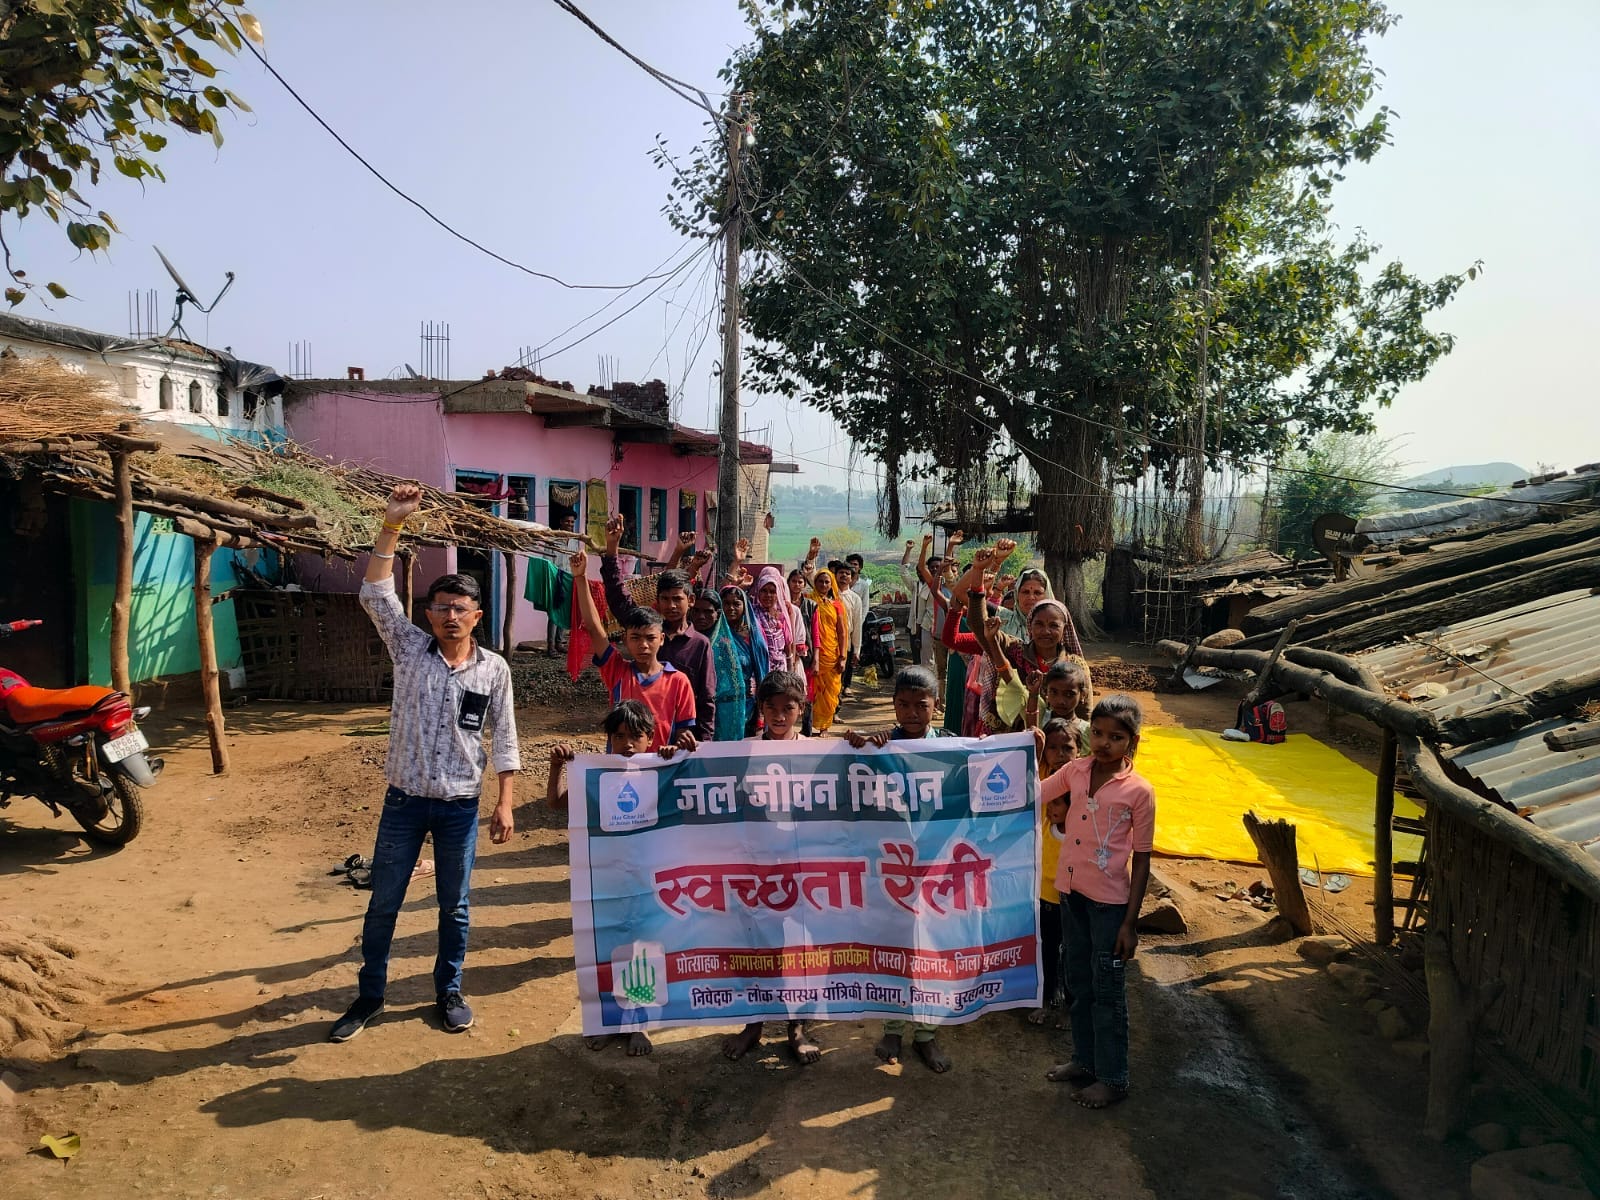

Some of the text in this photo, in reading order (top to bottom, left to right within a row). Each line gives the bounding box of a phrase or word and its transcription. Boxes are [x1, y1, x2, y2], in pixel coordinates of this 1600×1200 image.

[673, 763, 944, 815] जल जीवन मिशन
[654, 842, 991, 915] स्वच्छता रैली
[676, 953, 720, 974] प्रोत्साहक
[730, 954, 774, 971] आगाखान
[777, 953, 796, 970] ग्राम
[800, 947, 830, 969] समर्थन
[833, 945, 870, 966] कार्यक्रम
[873, 947, 906, 975] (भारत)
[910, 955, 951, 977] खकनार,
[955, 951, 980, 974] जिला
[983, 945, 1023, 972] बुरहानपुर
[692, 987, 733, 1007] निवेदक
[747, 984, 773, 1002] लोक
[776, 988, 818, 1002] स्वास्थ्य
[822, 981, 862, 1001] यांत्रिकी
[866, 982, 906, 1007] विभाग,
[910, 986, 941, 1004] जिला
[952, 982, 1002, 1010] बुरहानपुर
